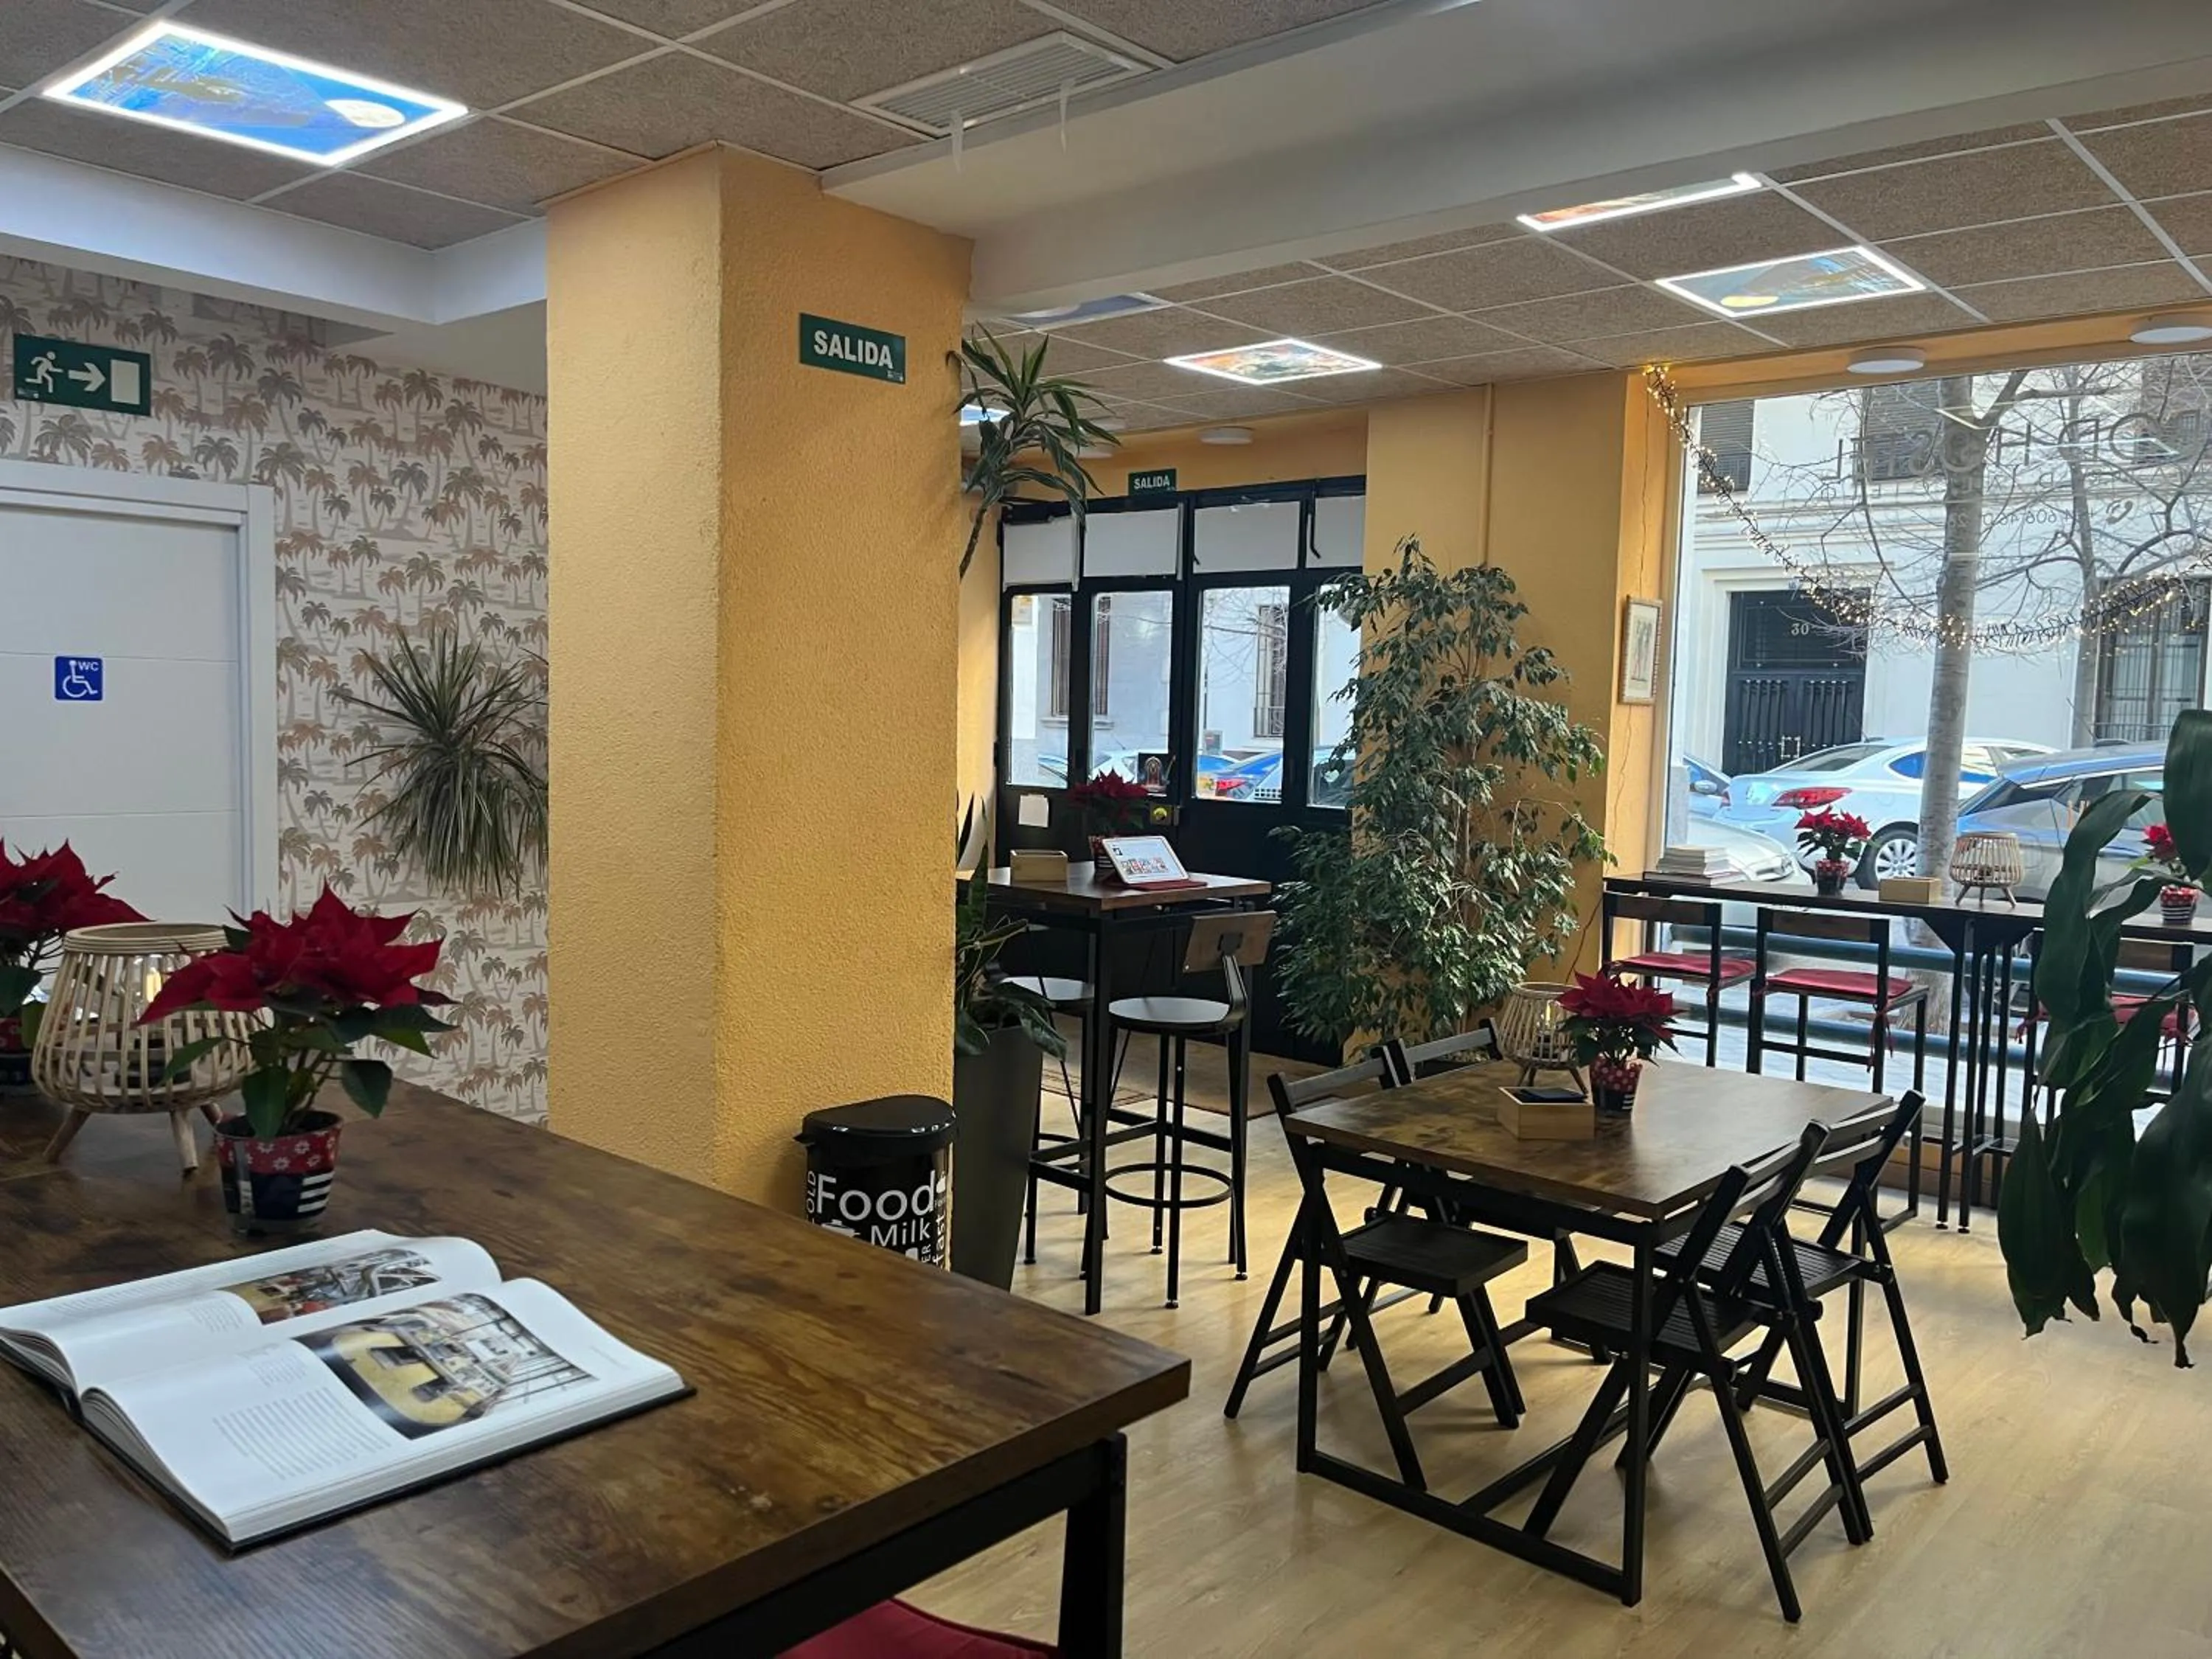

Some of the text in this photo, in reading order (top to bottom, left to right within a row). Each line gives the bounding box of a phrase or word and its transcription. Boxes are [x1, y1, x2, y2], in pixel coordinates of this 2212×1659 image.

[813, 330, 894, 369] SALIDA
[1133, 475, 1170, 490] SALIDA
[1791, 623, 1809, 636] 30
[77, 661, 99, 672] WC
[806, 1170, 816, 1224] OLD
[816, 1169, 936, 1221] Food
[871, 1217, 931, 1247] Milk
[932, 1209, 945, 1269] fast
